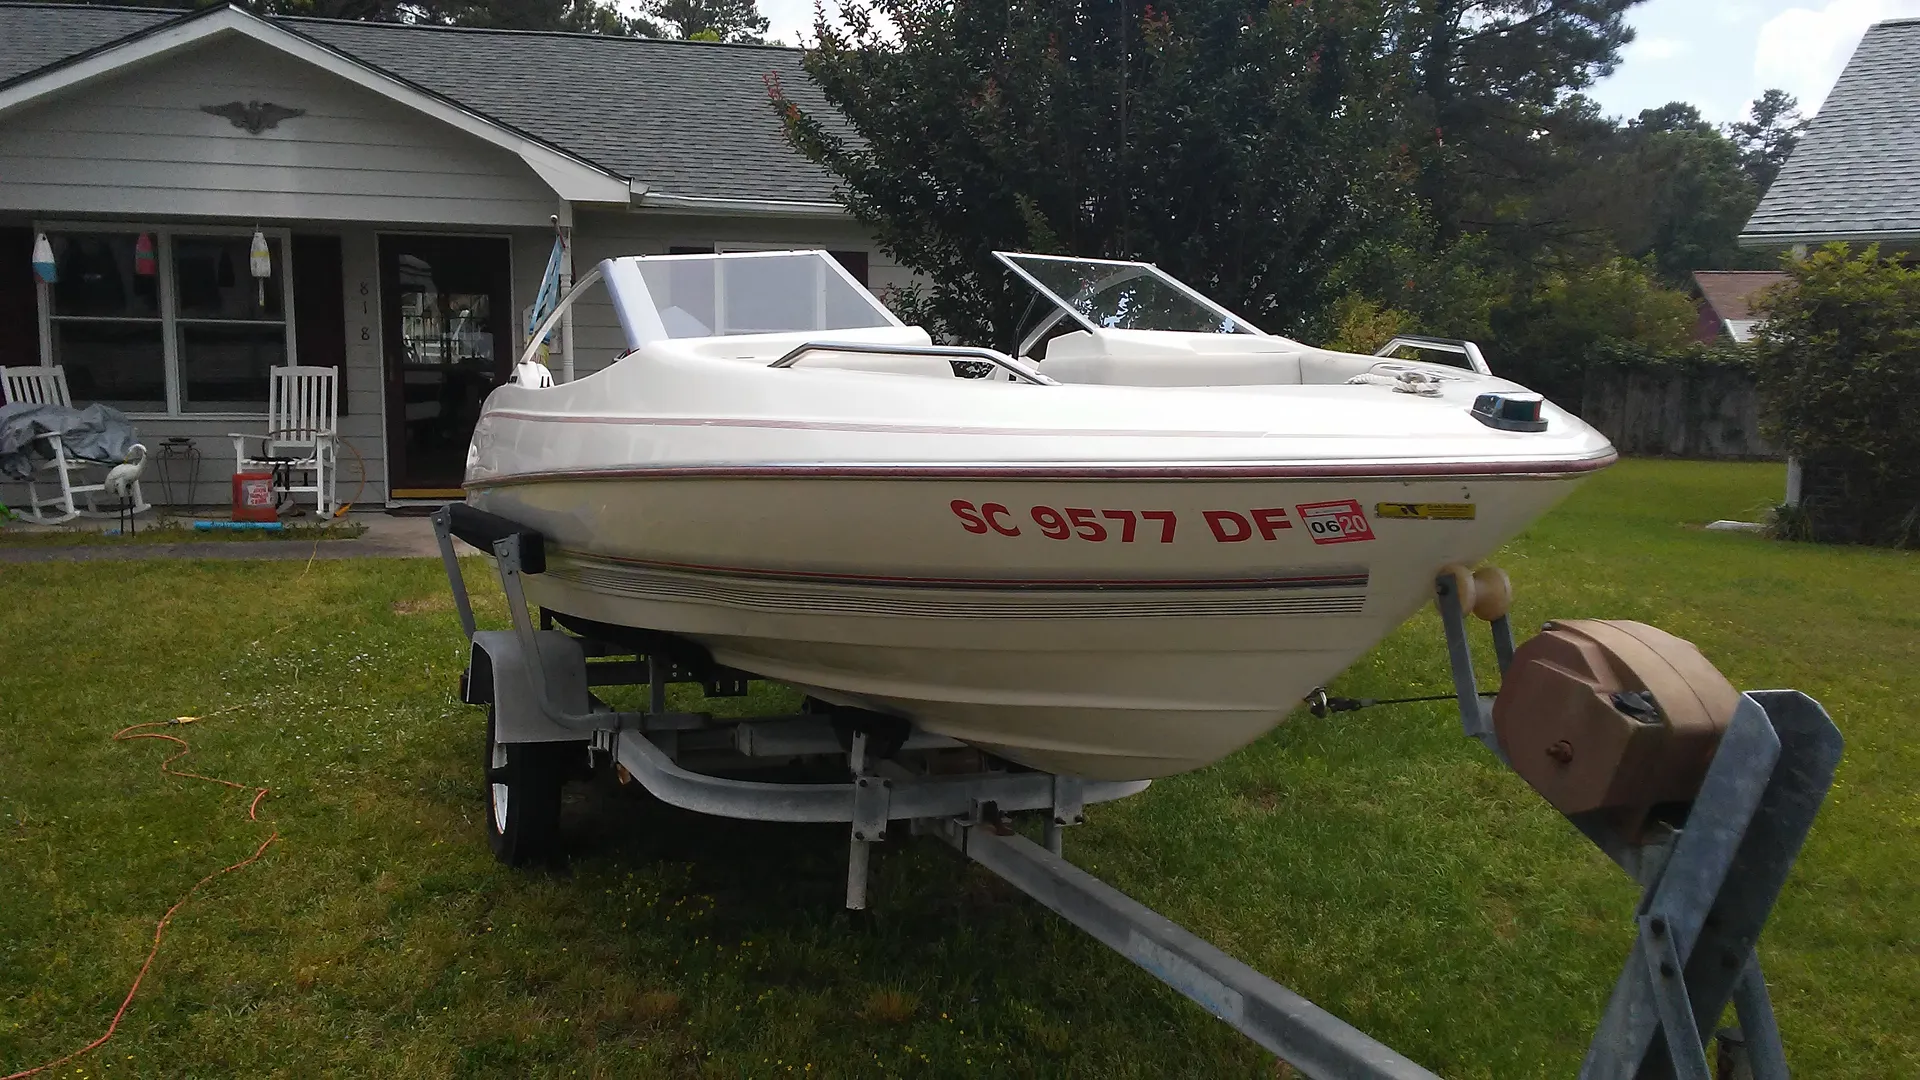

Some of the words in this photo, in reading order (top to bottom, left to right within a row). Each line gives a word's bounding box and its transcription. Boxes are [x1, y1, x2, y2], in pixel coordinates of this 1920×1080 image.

[950, 499, 1022, 537] SC
[1030, 504, 1177, 544] 9577
[1202, 508, 1293, 543] DF
[1311, 520, 1341, 534] 06
[1339, 515, 1368, 534] 20
